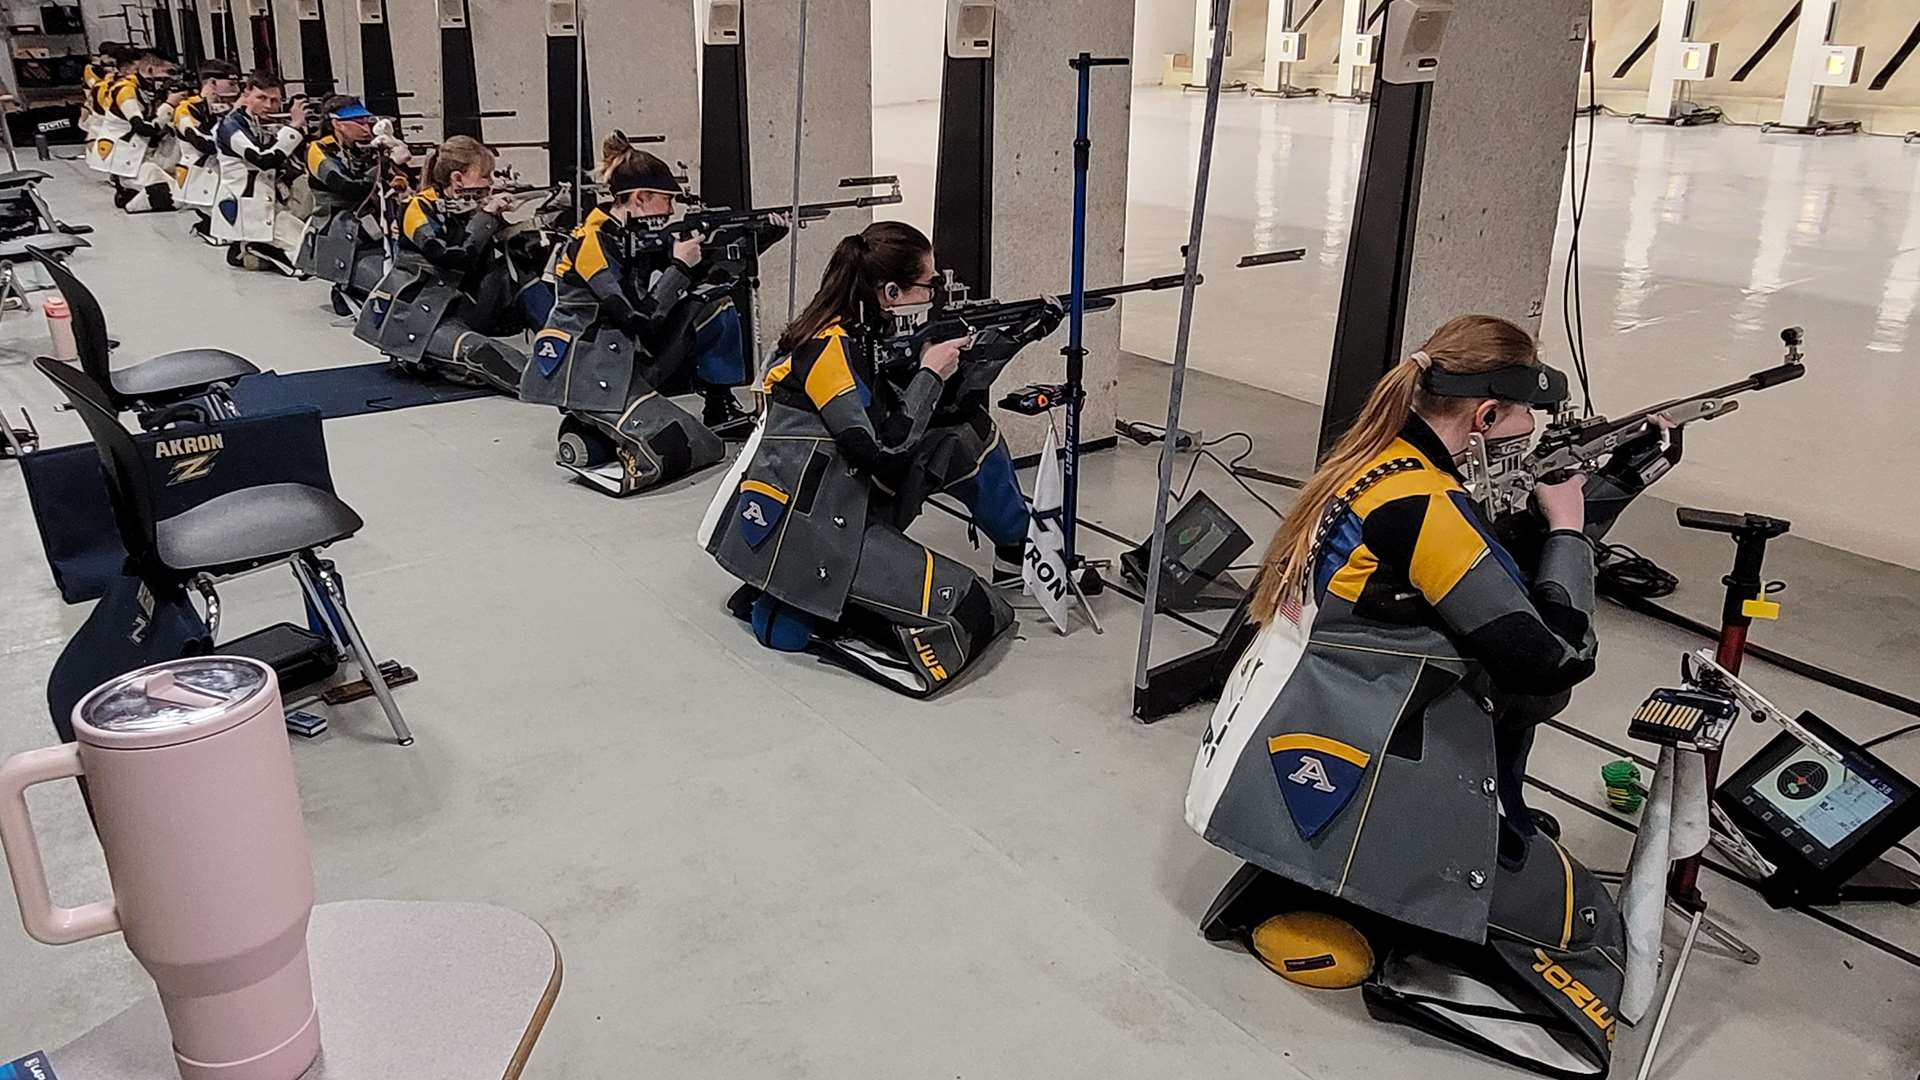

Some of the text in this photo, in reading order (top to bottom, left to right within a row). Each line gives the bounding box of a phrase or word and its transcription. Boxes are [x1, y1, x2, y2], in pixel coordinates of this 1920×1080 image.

[537, 341, 558, 359] A
[155, 433, 224, 459] AKRON
[169, 452, 217, 485] Z
[741, 500, 769, 527] A
[1025, 537, 1067, 601] RON
[1287, 755, 1337, 793] A
